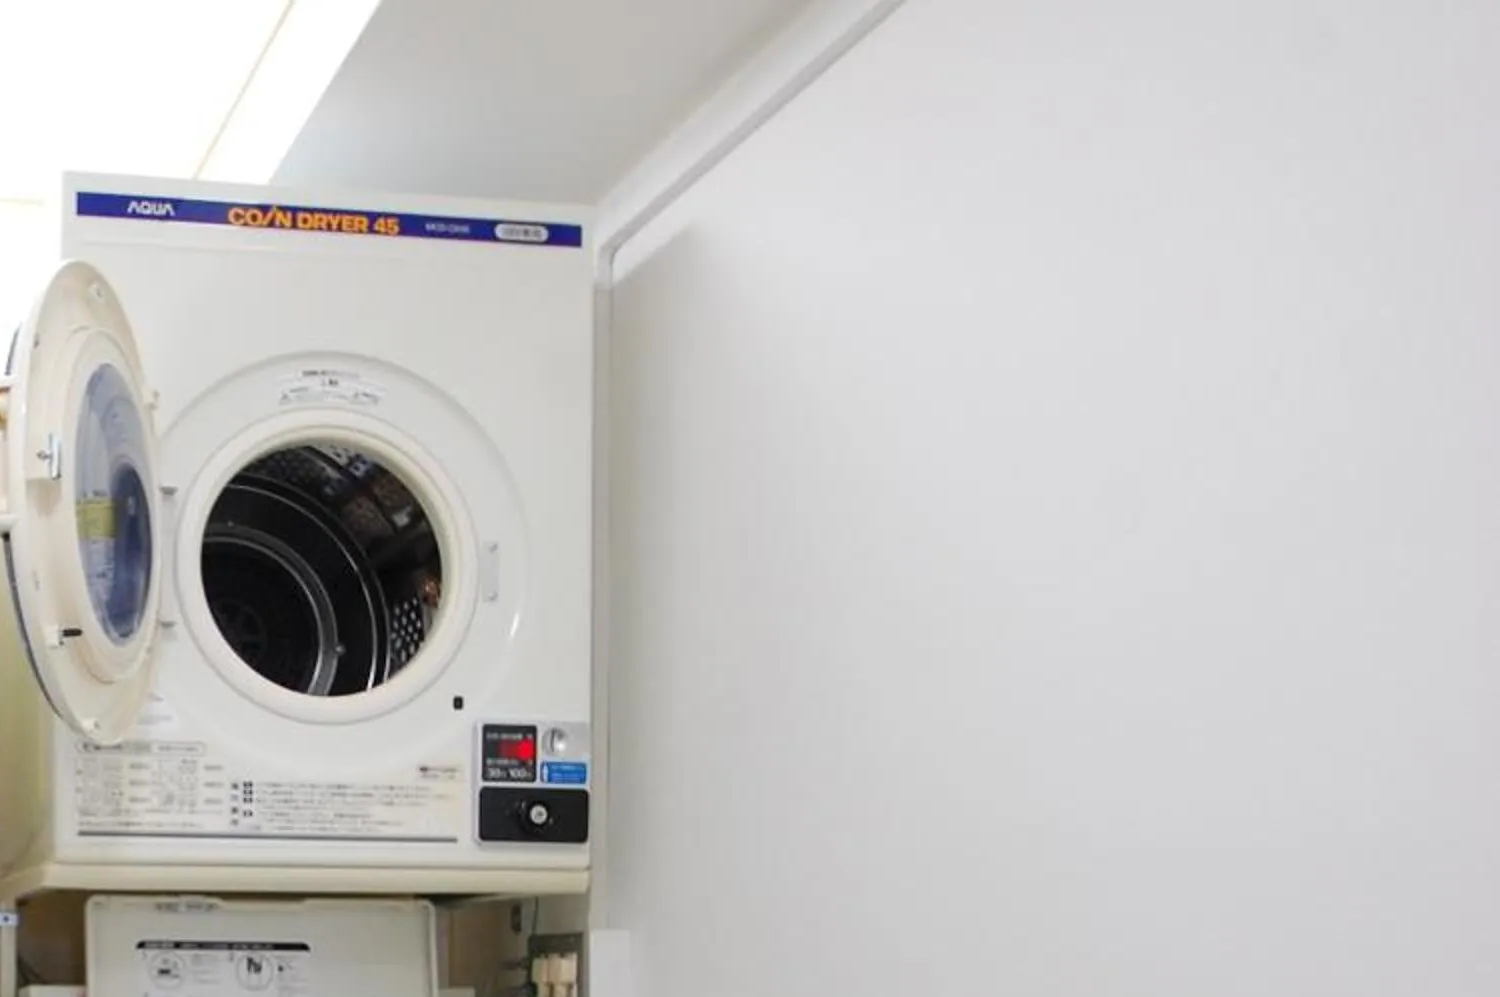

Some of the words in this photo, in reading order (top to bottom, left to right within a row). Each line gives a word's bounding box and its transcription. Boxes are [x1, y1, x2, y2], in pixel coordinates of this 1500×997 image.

[127, 201, 175, 216] AQUA
[227, 206, 293, 229] COIN
[296, 213, 368, 233] DRYER
[373, 219, 399, 236] 45
